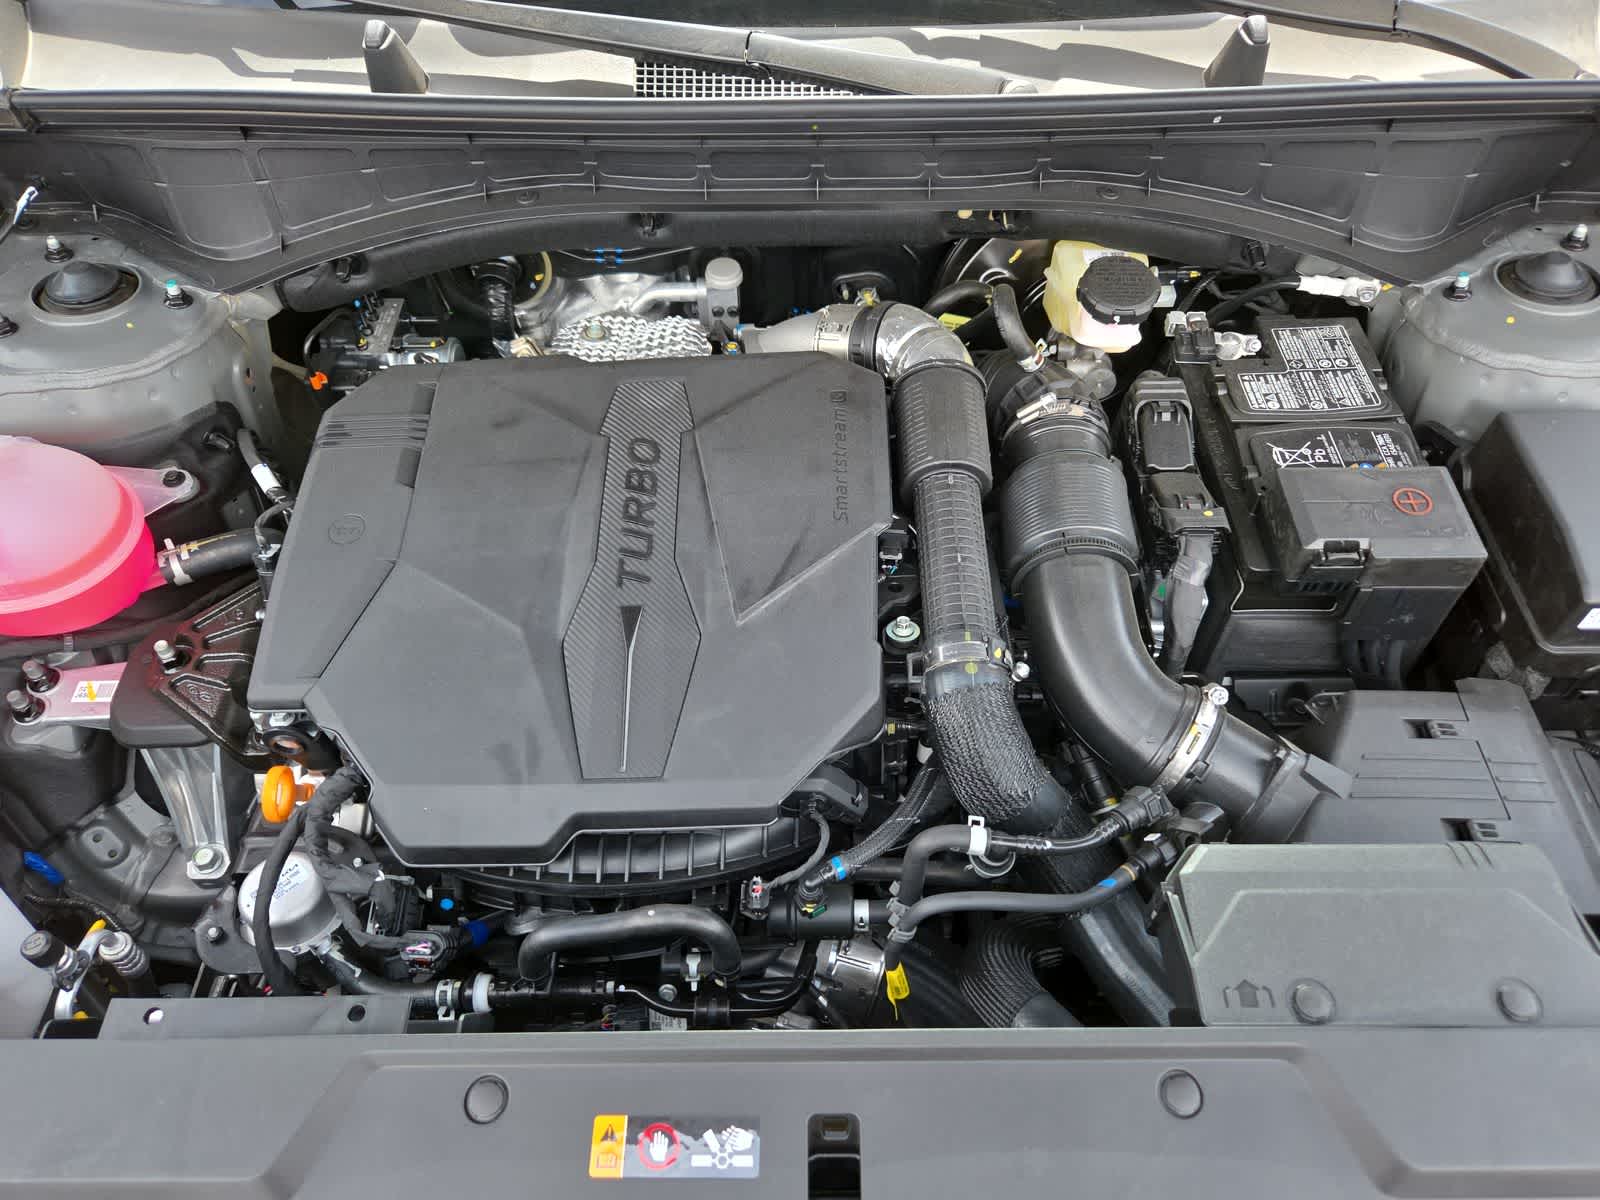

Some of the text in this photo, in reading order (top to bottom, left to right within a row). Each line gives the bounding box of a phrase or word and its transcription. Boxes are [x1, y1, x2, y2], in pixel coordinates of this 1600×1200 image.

[617, 436, 661, 588] TURBO
[832, 406, 849, 524] Smartstream
[1313, 448, 1329, 463] Pb
